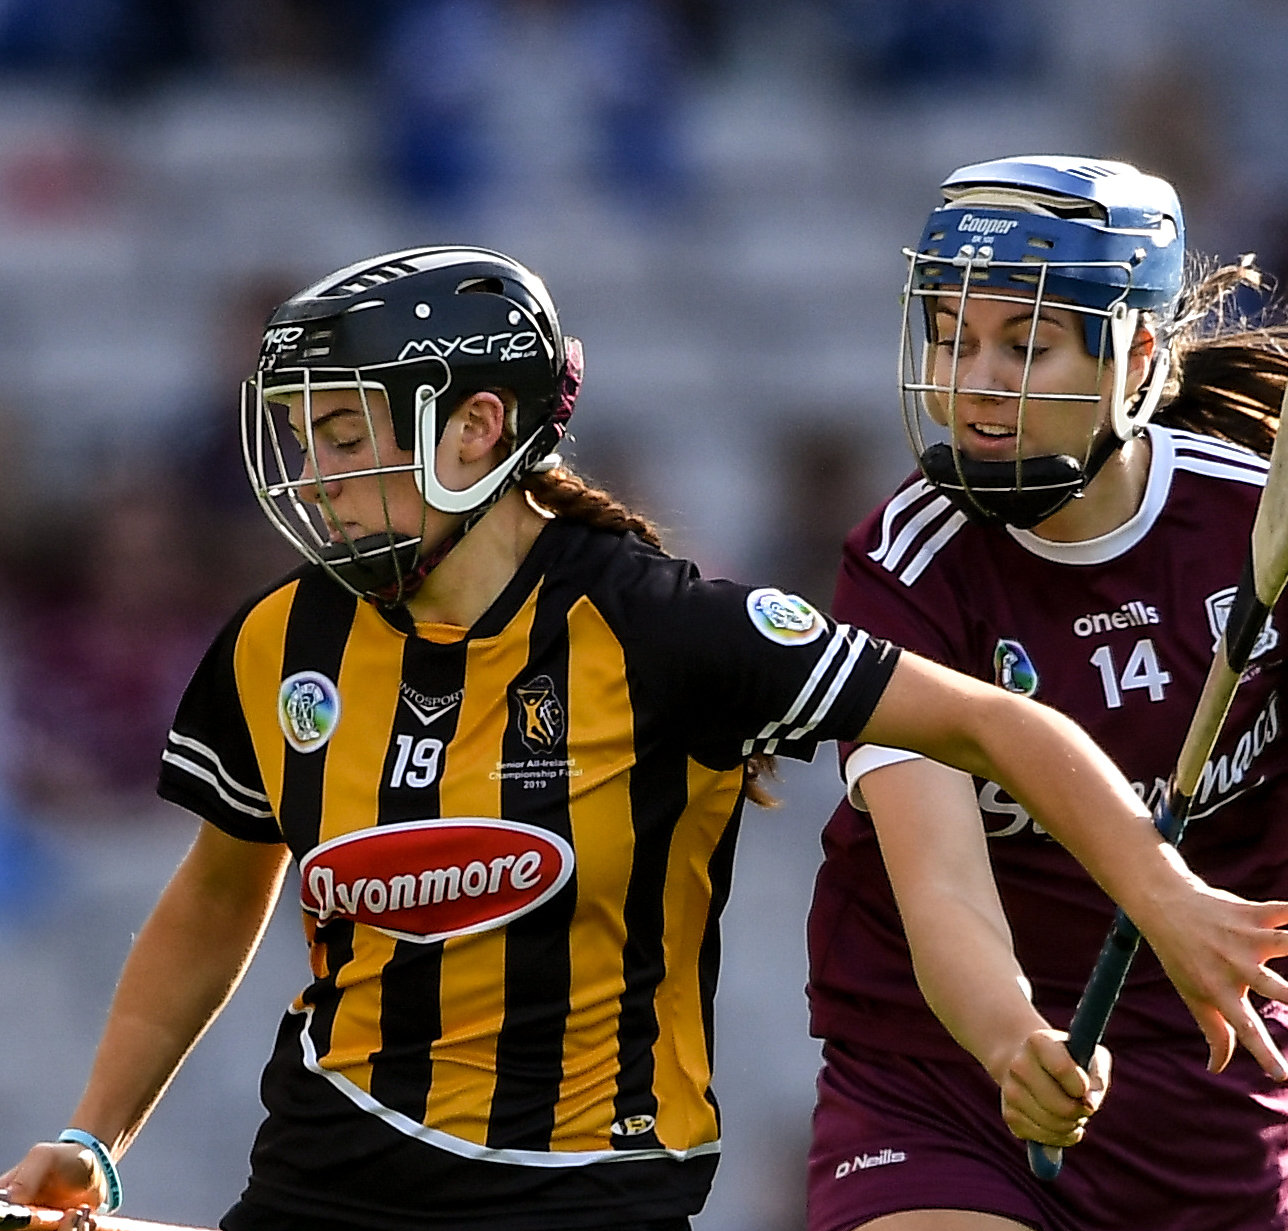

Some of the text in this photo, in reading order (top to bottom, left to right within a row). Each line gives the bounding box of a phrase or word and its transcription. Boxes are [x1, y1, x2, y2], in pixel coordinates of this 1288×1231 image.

[958, 213, 1018, 235] Cooper
[1090, 639, 1172, 709] 14
[390, 734, 443, 788] 19
[495, 758, 576, 770] Senior All-Ireland
[488, 768, 584, 780] Championship Final
[523, 780, 547, 789] 2019
